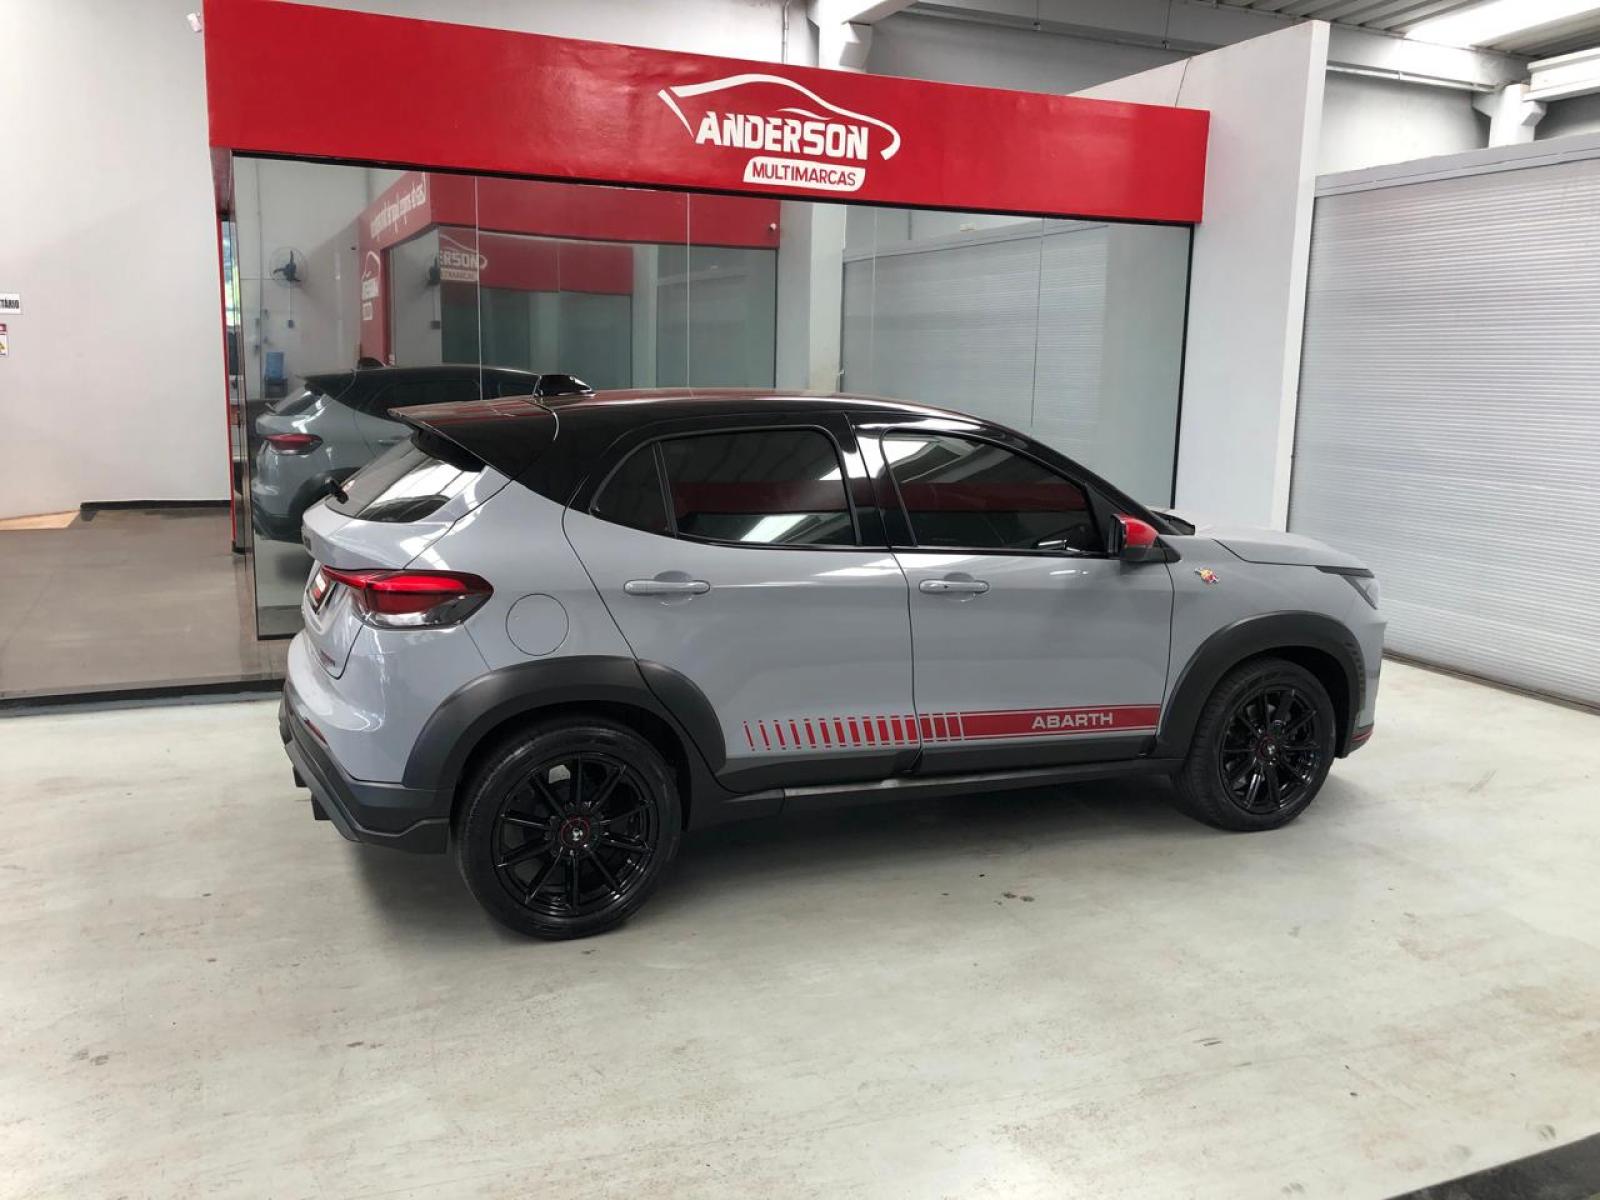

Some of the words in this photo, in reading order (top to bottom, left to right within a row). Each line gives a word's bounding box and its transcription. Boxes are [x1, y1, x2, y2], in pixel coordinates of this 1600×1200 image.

[695, 111, 869, 161] ANDERSON
[751, 161, 857, 187] MULTIMARCAS
[0, 298, 19, 309] TÁRIO
[1031, 712, 1114, 729] ABARTH
